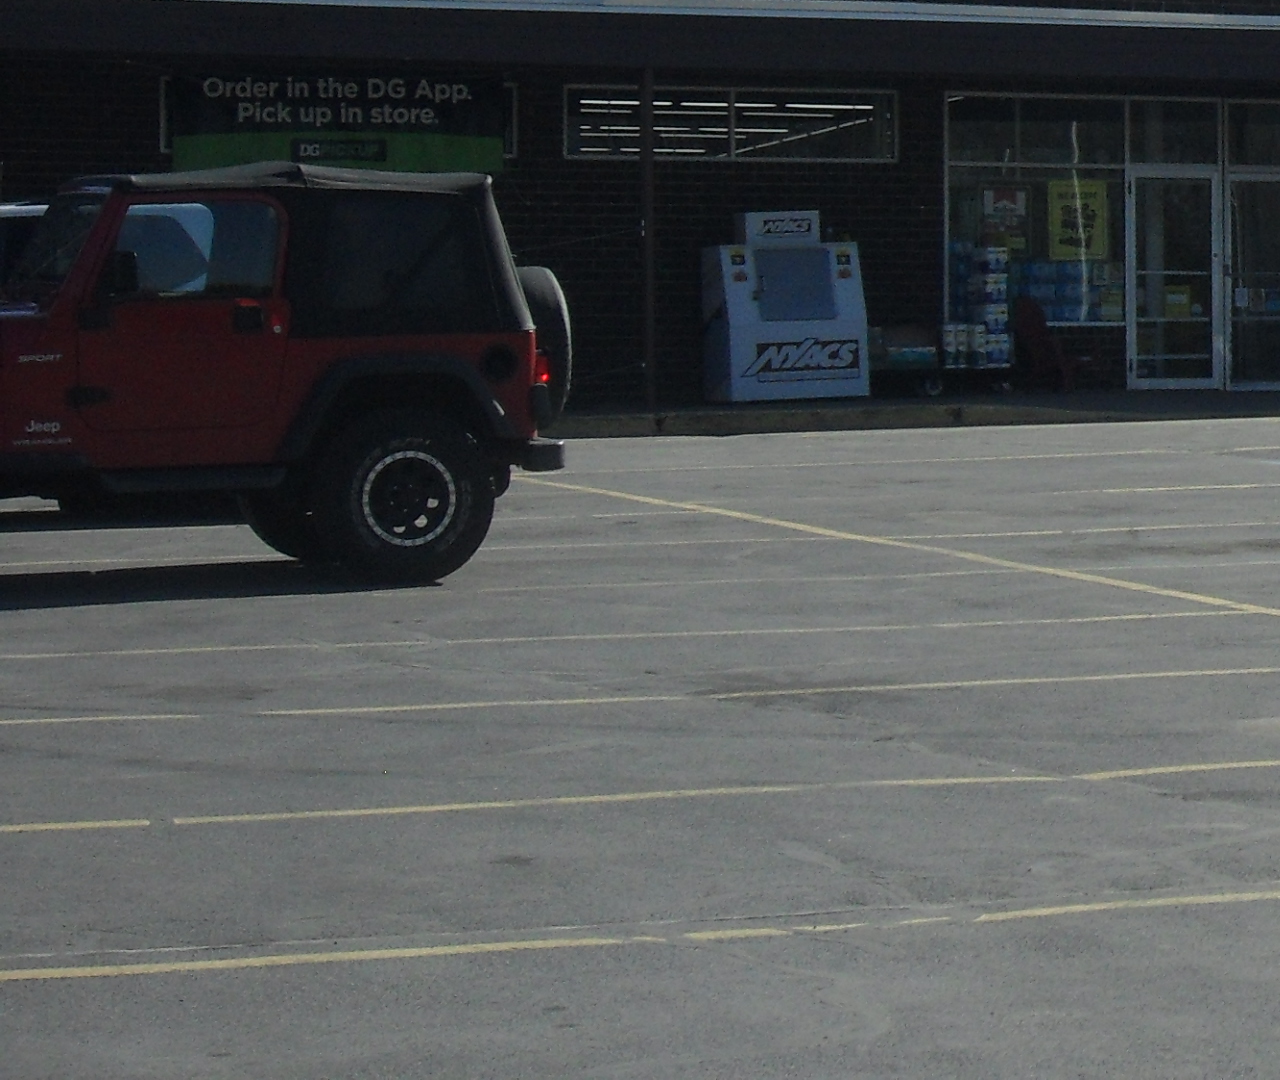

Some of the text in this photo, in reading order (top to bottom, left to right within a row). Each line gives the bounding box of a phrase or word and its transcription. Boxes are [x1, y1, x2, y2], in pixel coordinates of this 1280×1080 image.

[203, 77, 472, 103] Order in the DG App.
[237, 102, 440, 126] Pick up in store.
[18, 354, 62, 362] SPORT
[741, 337, 859, 377] NYACS
[25, 420, 60, 433] Jeep
